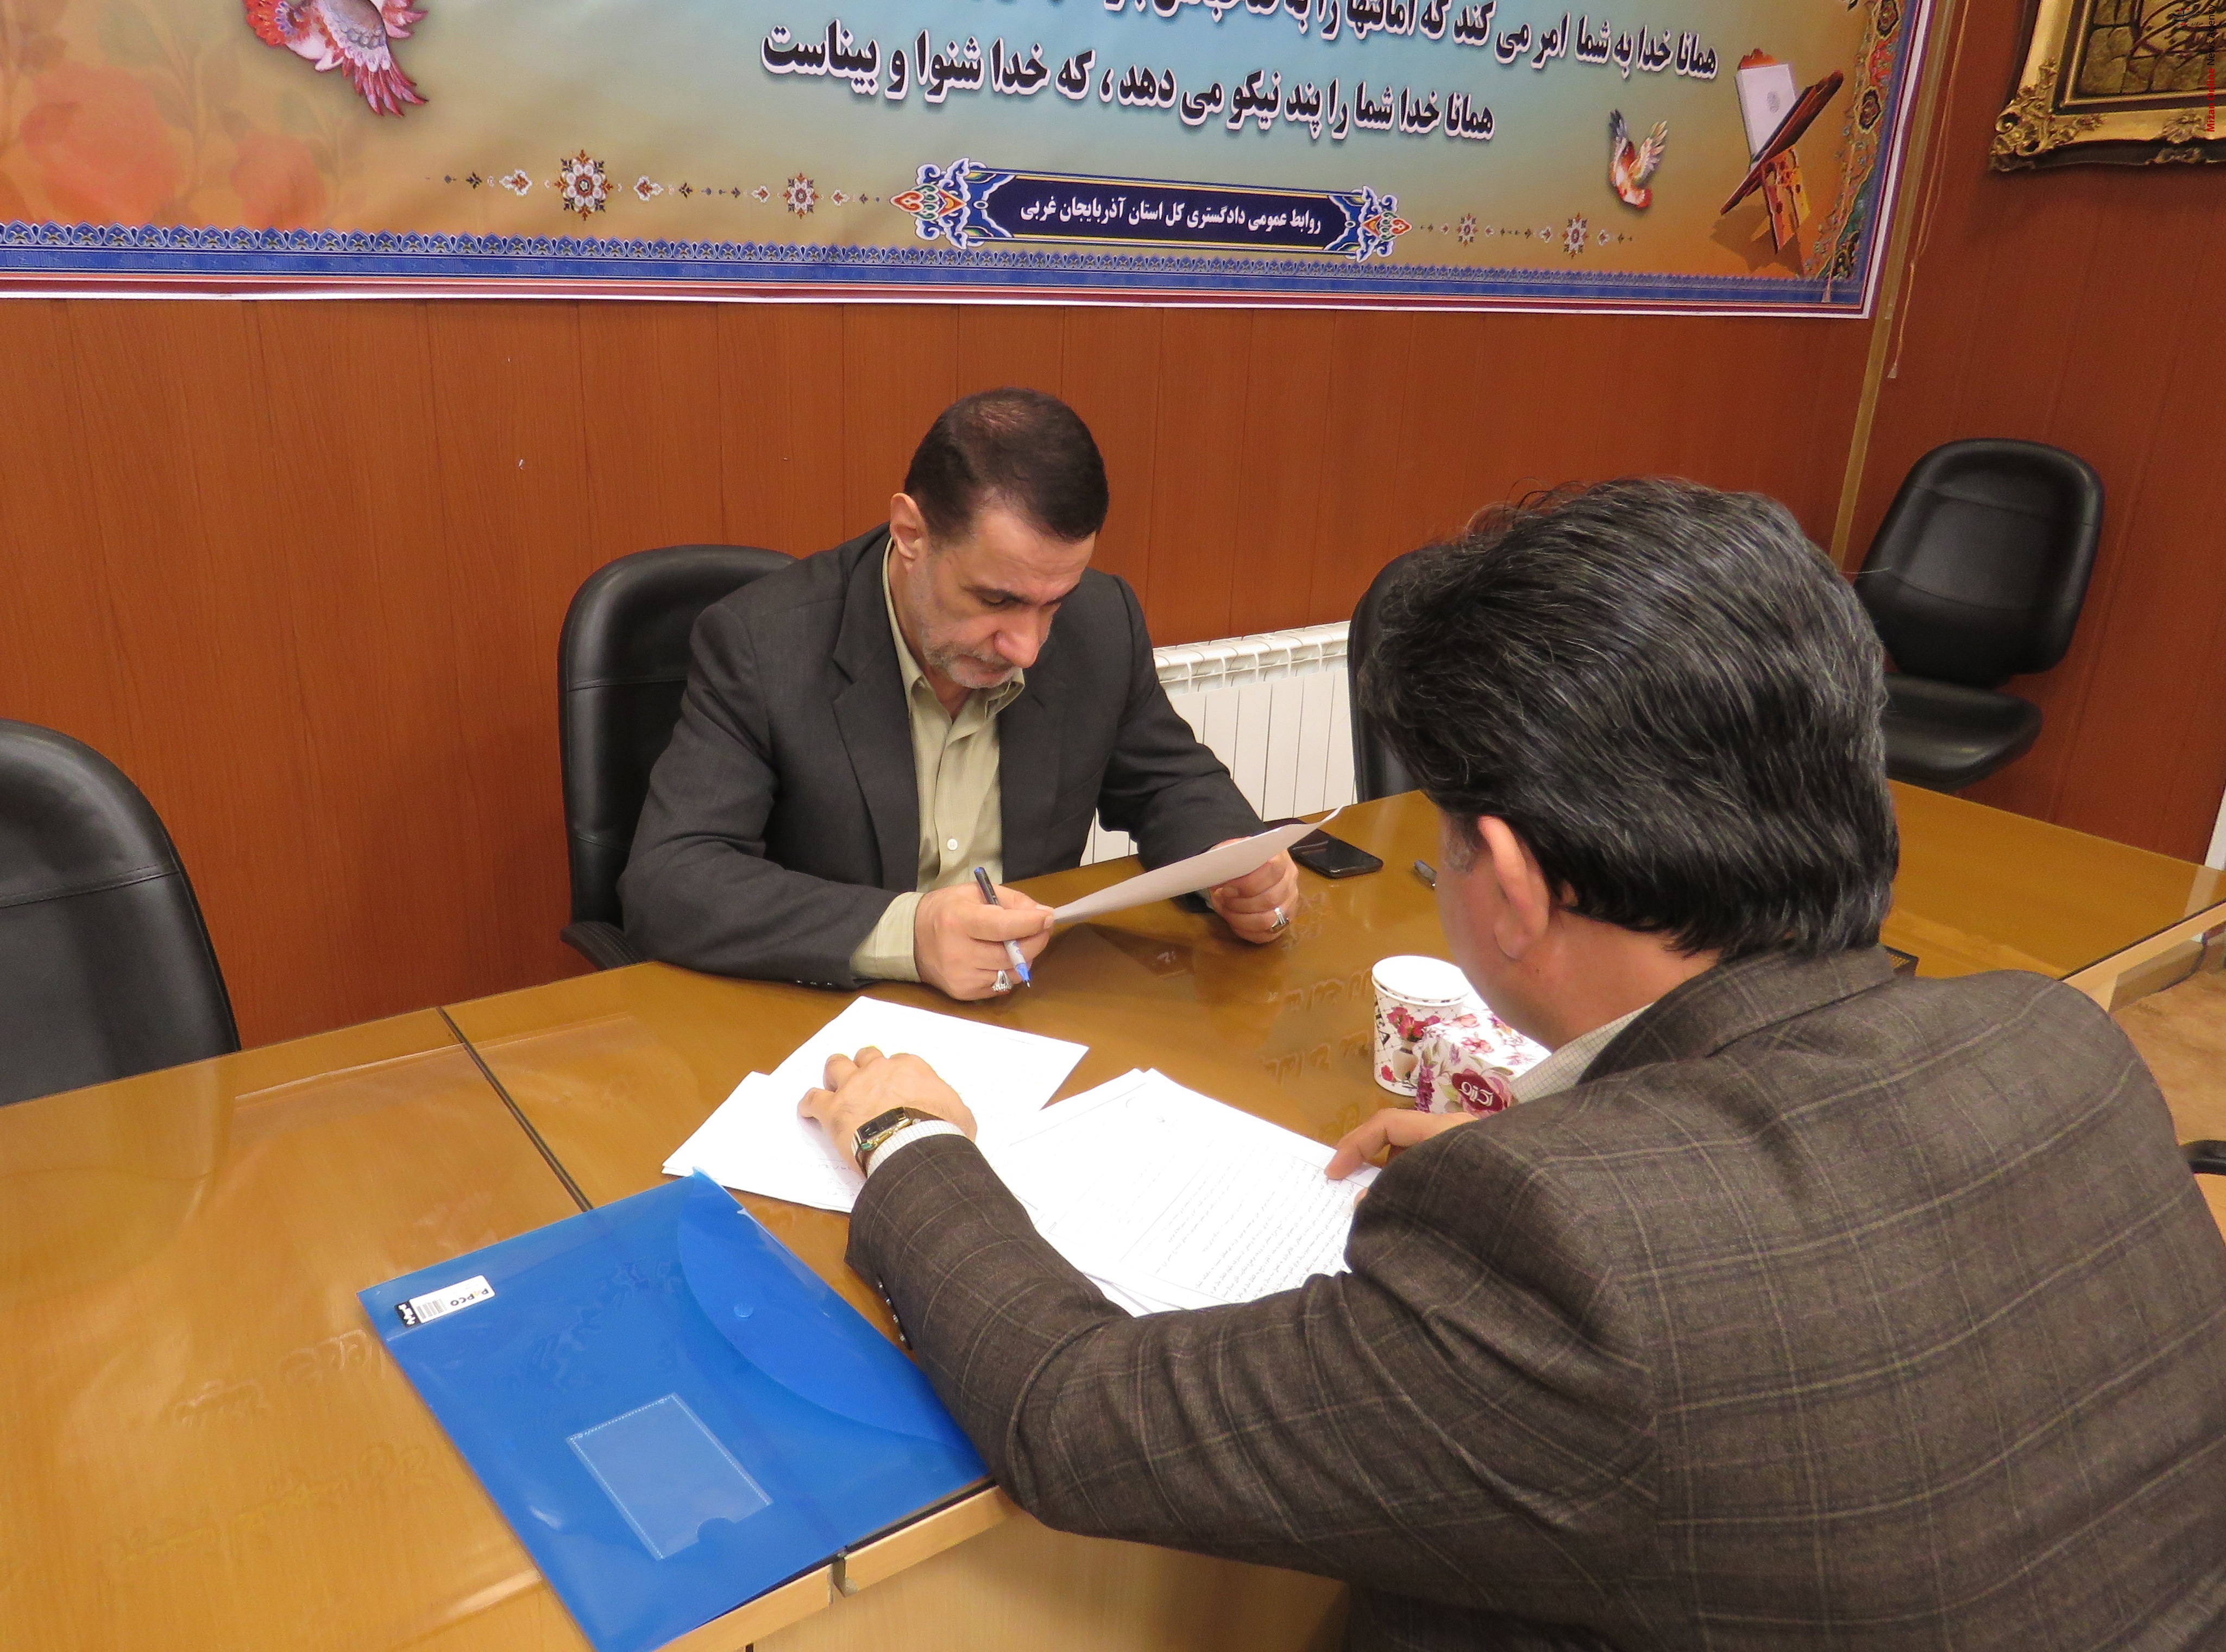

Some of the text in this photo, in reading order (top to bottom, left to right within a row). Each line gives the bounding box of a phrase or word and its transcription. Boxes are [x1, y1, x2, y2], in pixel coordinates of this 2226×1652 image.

[1418, 0, 1451, 41] که
[1452, 0, 1496, 46] کند
[1494, 22, 1531, 64] می
[1530, 11, 1571, 70] امر
[1575, 14, 1611, 65] شما
[761, 19, 881, 96] بیناست
[915, 28, 985, 103] شنوا
[990, 37, 1051, 95] خدا
[1612, 31, 1633, 79] به
[1637, 24, 1674, 72] خدا
[1675, 32, 1718, 80] همانا
[884, 49, 909, 100] و
[1055, 49, 1096, 100] که
[1179, 81, 1225, 127] می
[1226, 70, 1282, 131] نیکو
[1284, 81, 1323, 140] پند
[1326, 78, 1350, 140] را
[1353, 81, 1394, 130] شما
[1398, 86, 1442, 135] خدا
[1444, 91, 1494, 140] همانا
[1020, 194, 1322, 235] روابط عمومی دادگستری کل استان آذربایجان غربی
[450, 1288, 489, 1306] PAPCO
